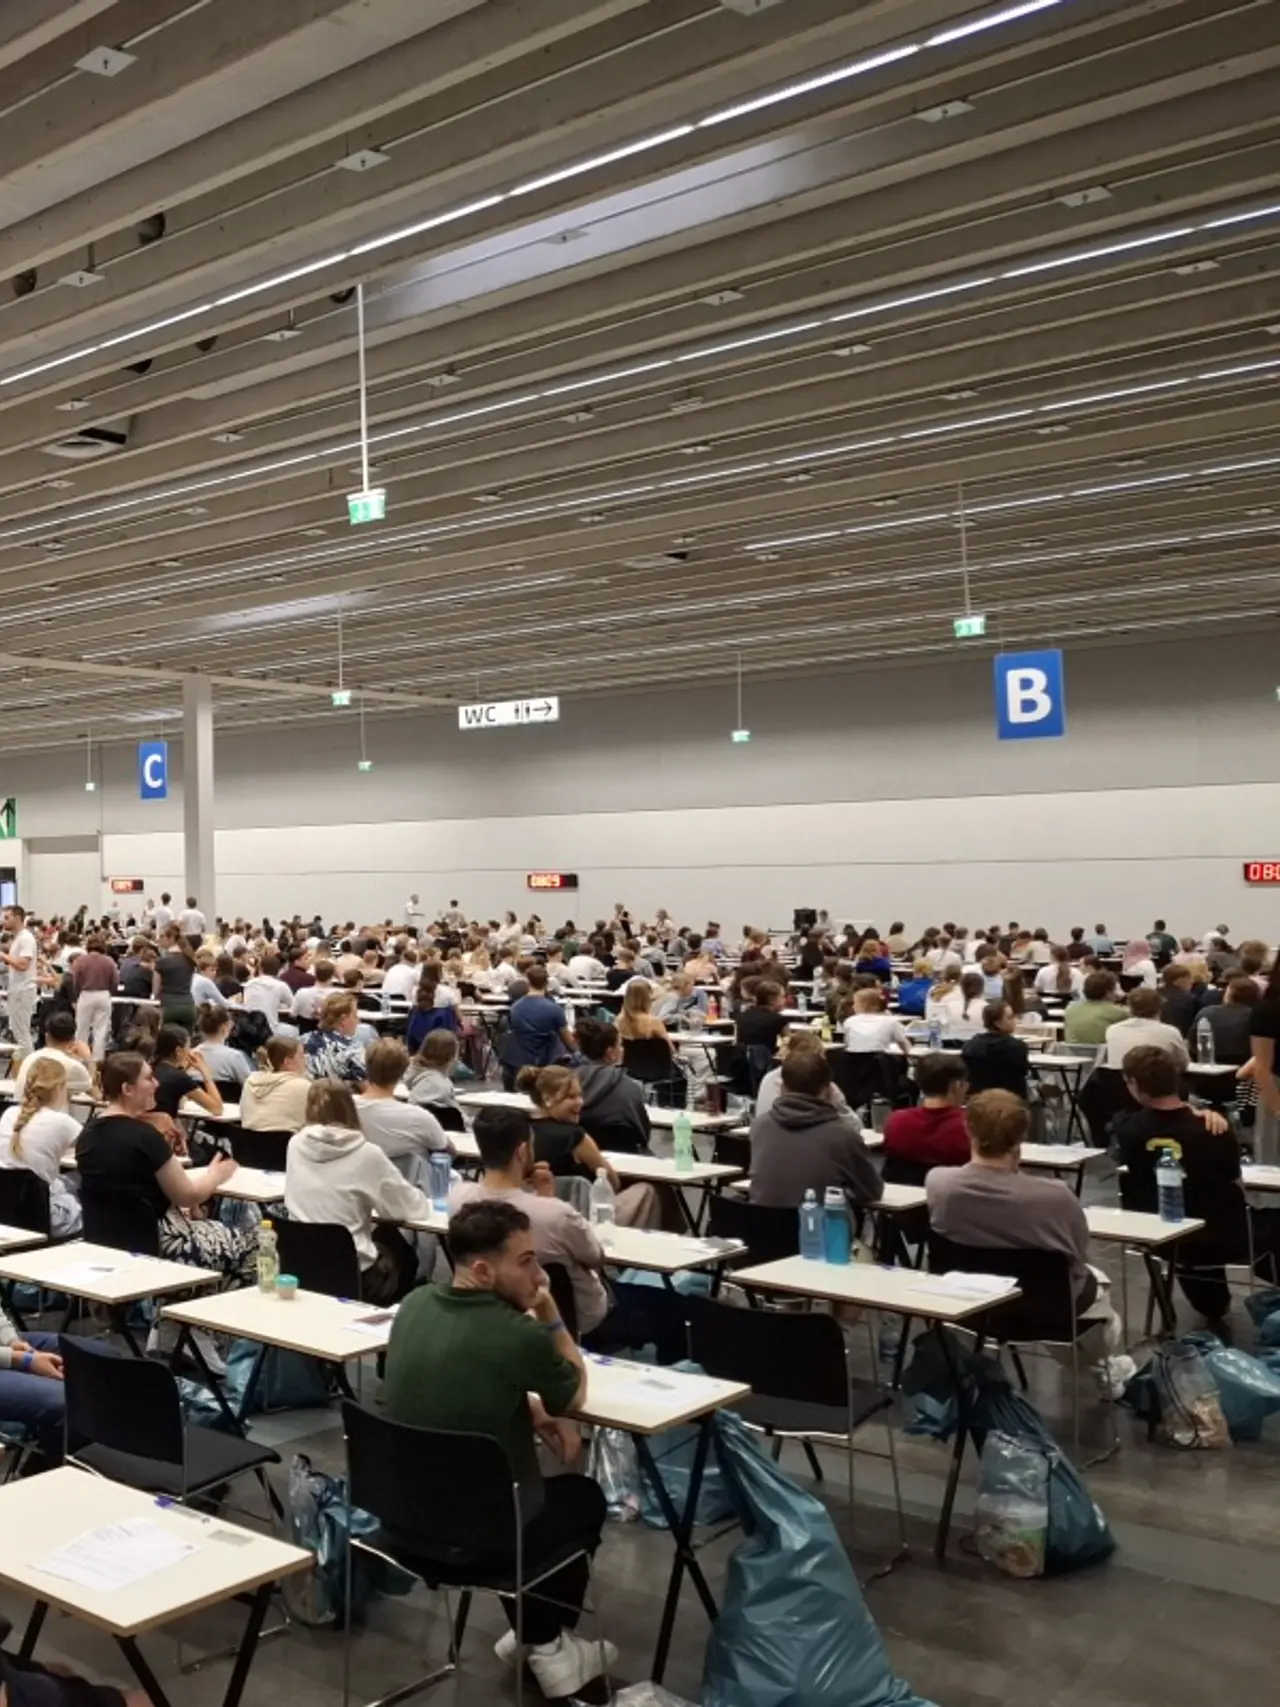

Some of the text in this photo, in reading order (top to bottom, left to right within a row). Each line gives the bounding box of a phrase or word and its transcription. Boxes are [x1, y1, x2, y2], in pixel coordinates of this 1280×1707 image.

[1006, 667, 1052, 724] B
[464, 706, 497, 725] WC
[143, 753, 164, 789] C
